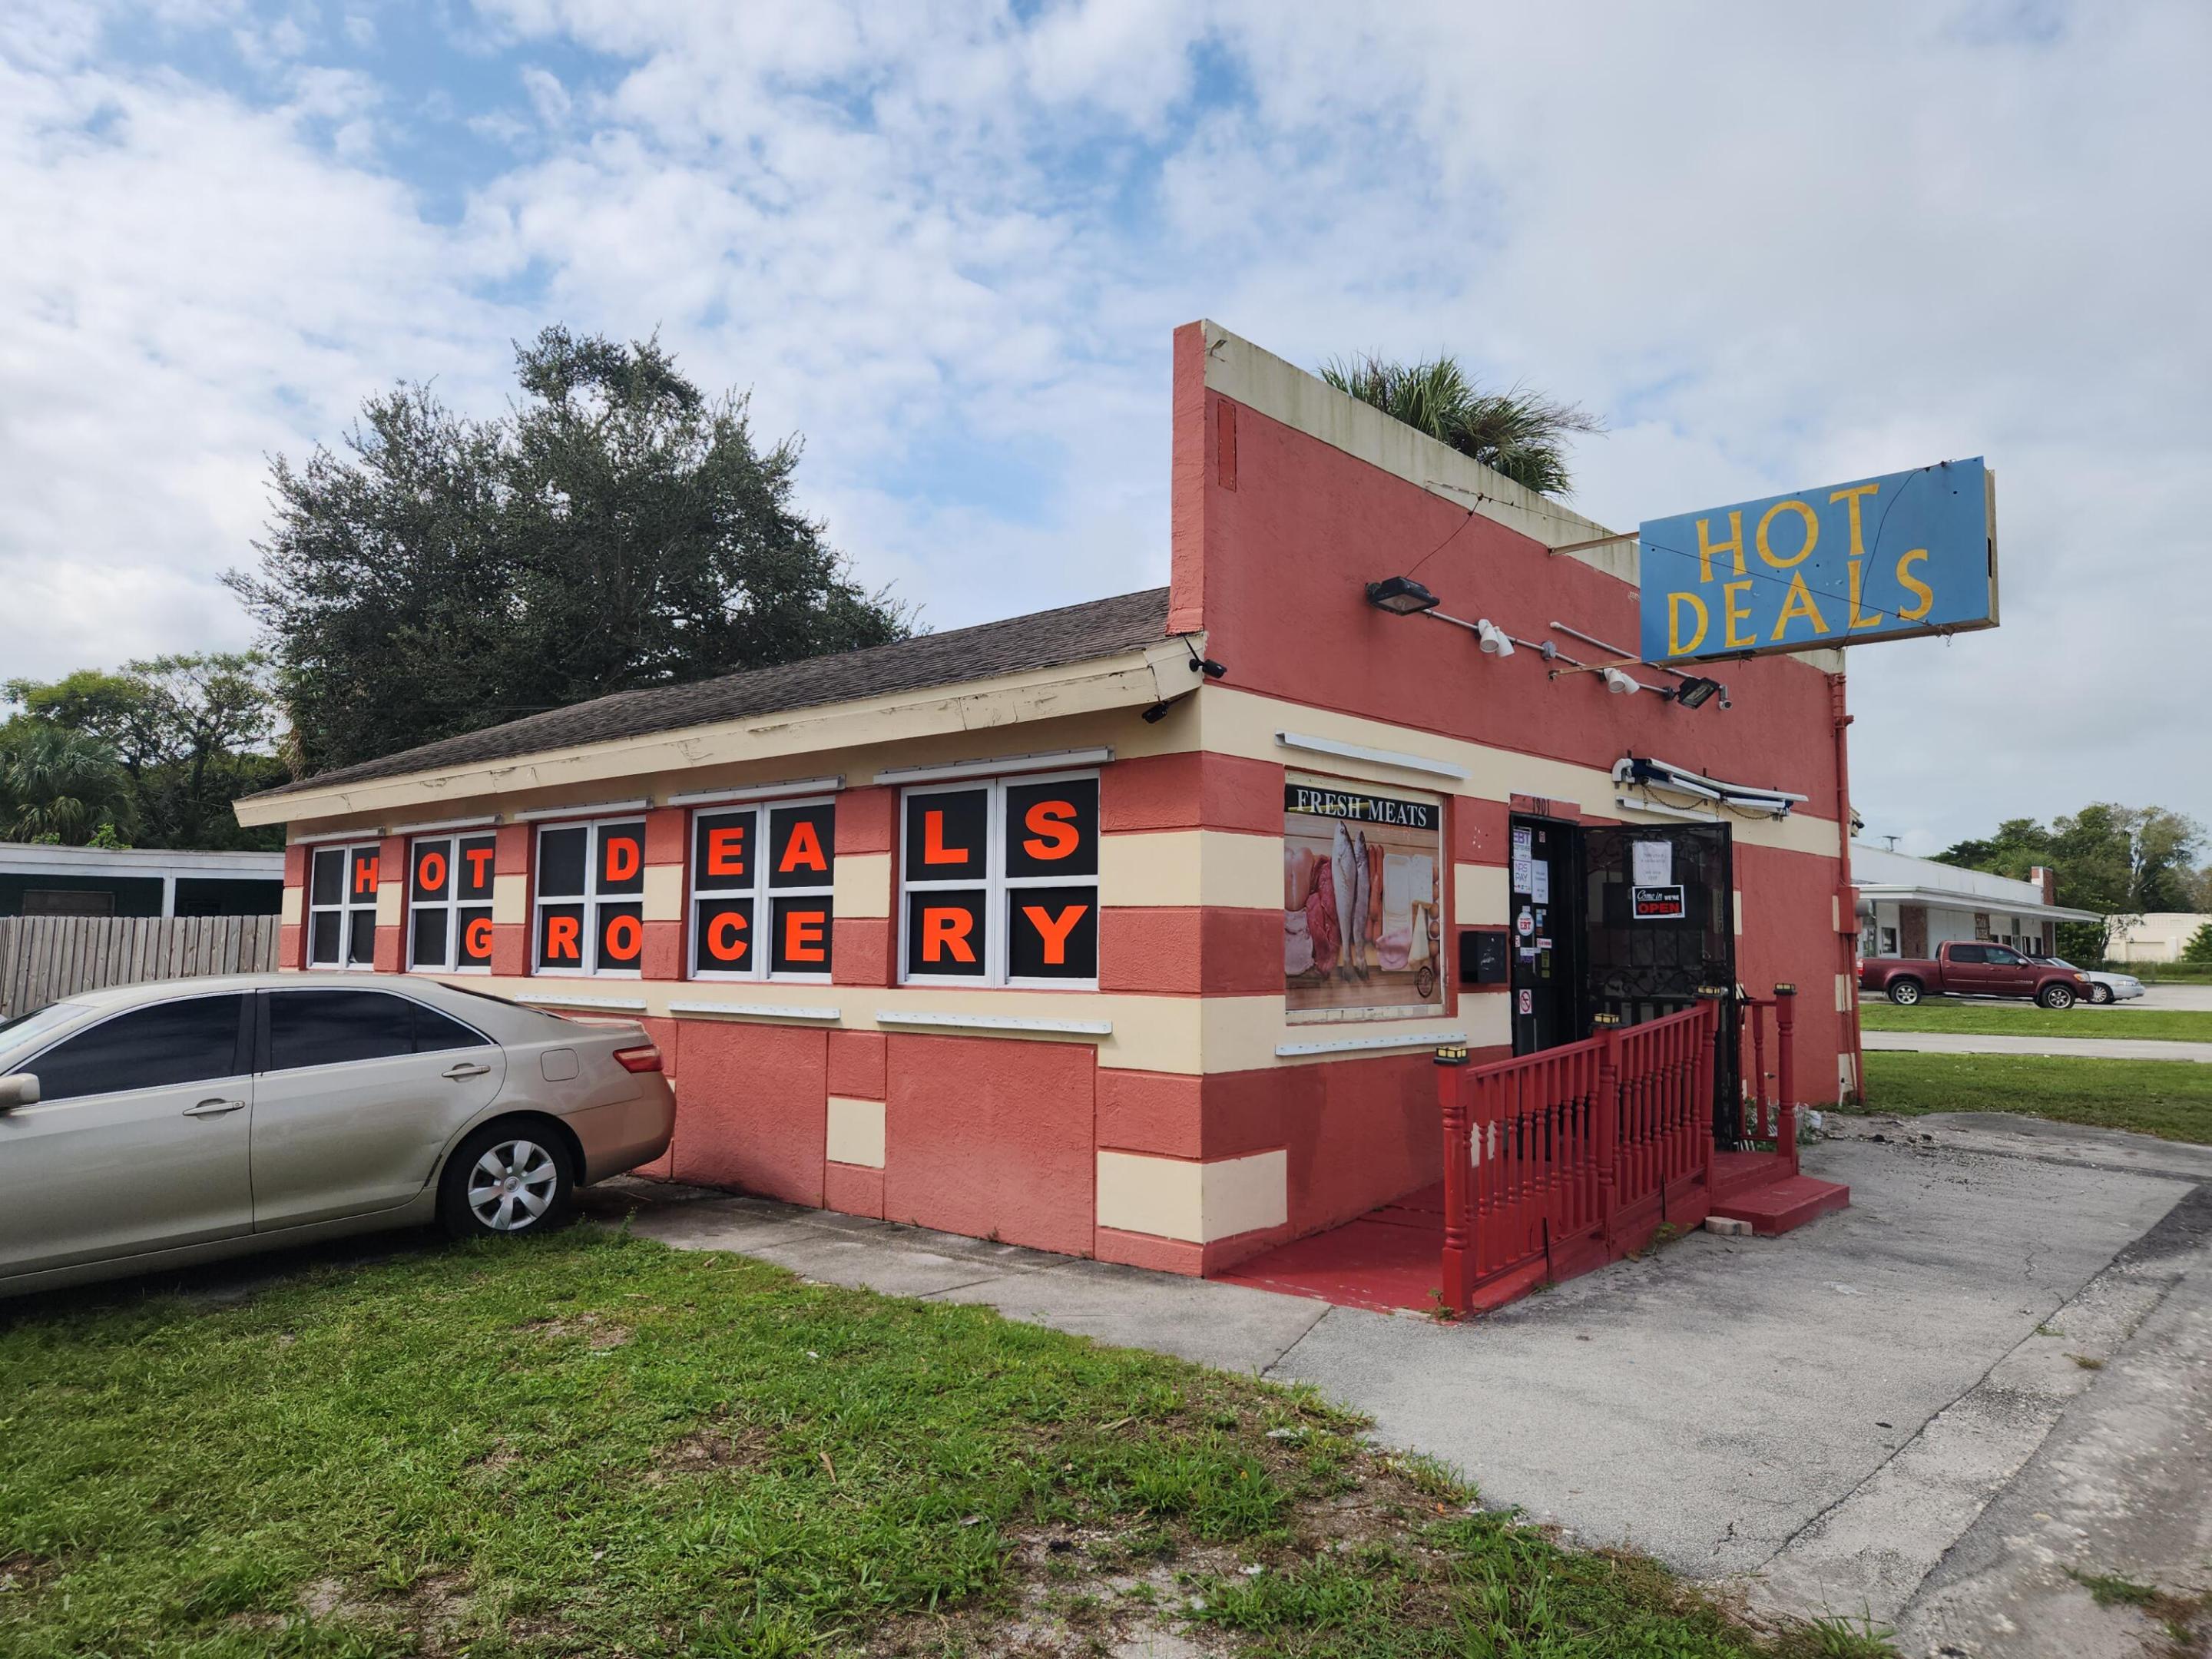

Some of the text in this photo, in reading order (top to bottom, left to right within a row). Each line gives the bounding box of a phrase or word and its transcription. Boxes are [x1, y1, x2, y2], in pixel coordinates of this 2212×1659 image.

[1695, 483, 1880, 584] HOT
[1667, 548, 1934, 657] DEALS
[1296, 789, 1428, 827] FRESH MEATS
[1532, 797, 1550, 817] 1901
[355, 800, 1080, 894] HOT DEALS
[1513, 830, 1531, 845] EBT
[1637, 889, 1655, 901] Come
[1637, 902, 1681, 914] OPEN
[465, 905, 1089, 965] GROCERY
[1520, 921, 1532, 930] EBT
